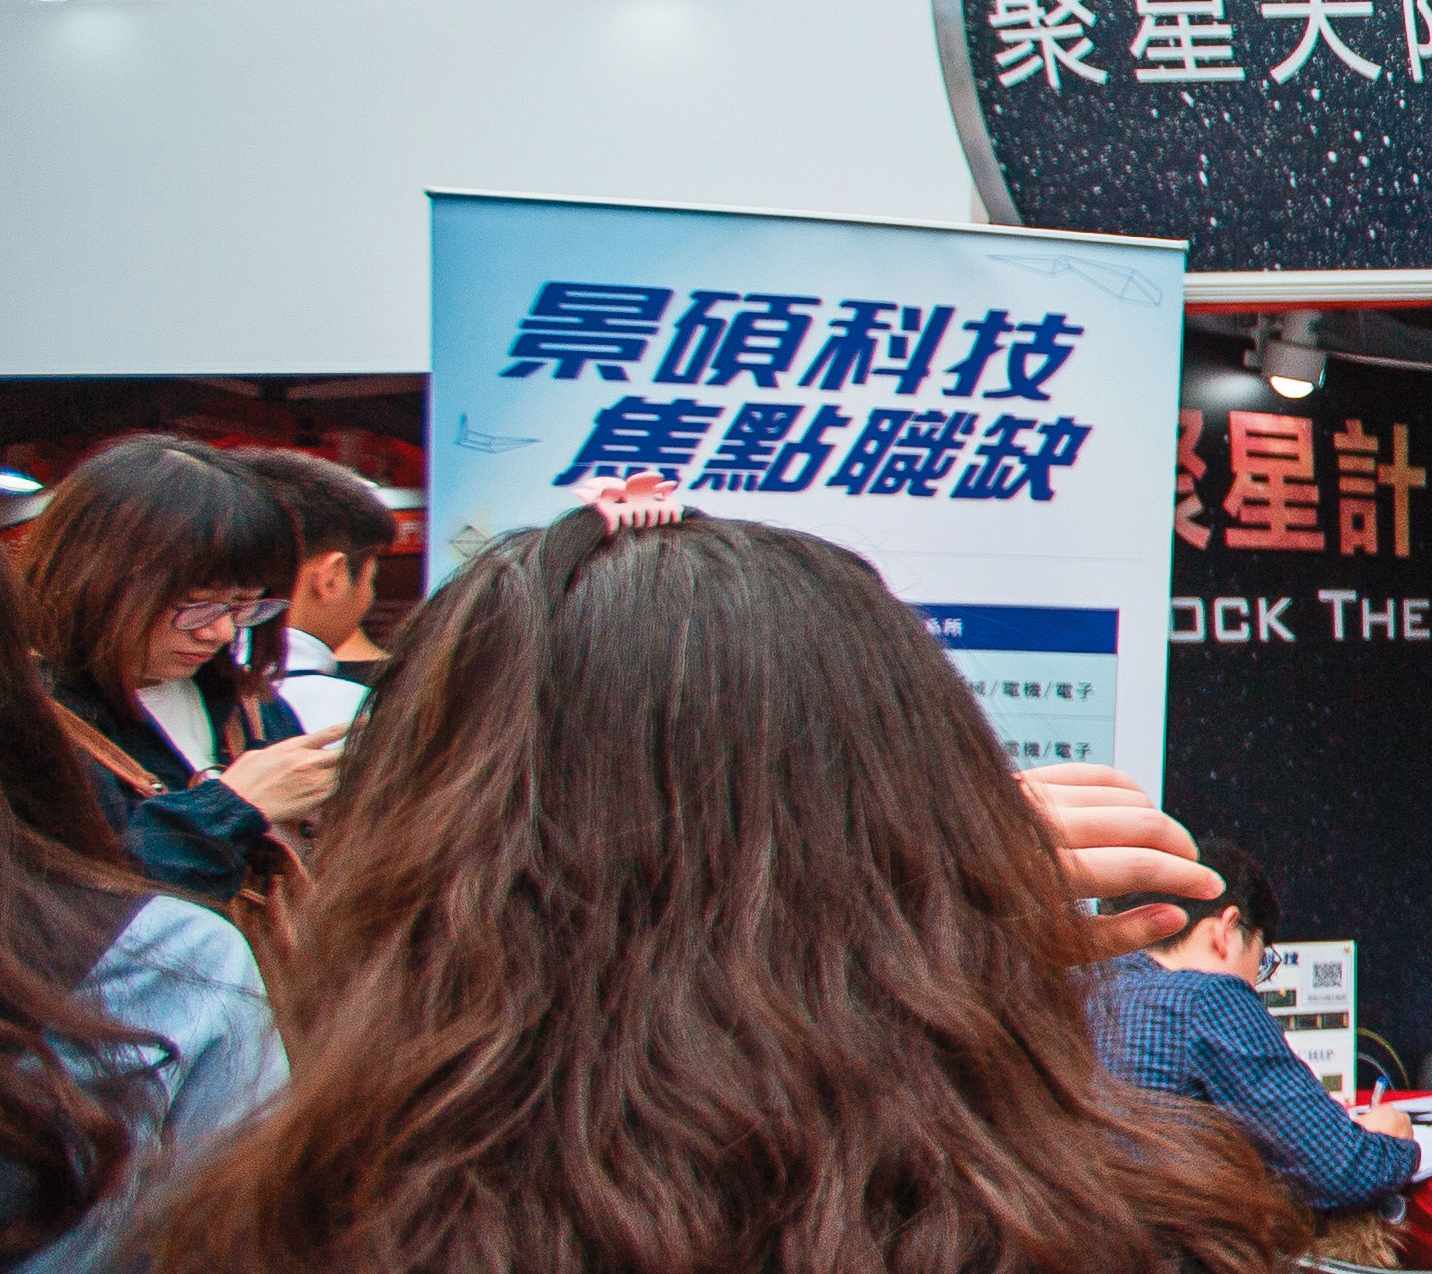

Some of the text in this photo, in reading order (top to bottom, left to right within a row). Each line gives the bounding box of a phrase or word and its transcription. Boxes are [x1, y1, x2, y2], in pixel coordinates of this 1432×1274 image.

[500, 281, 1085, 404] 景碩科技
[552, 395, 1094, 503] 焦點職缺
